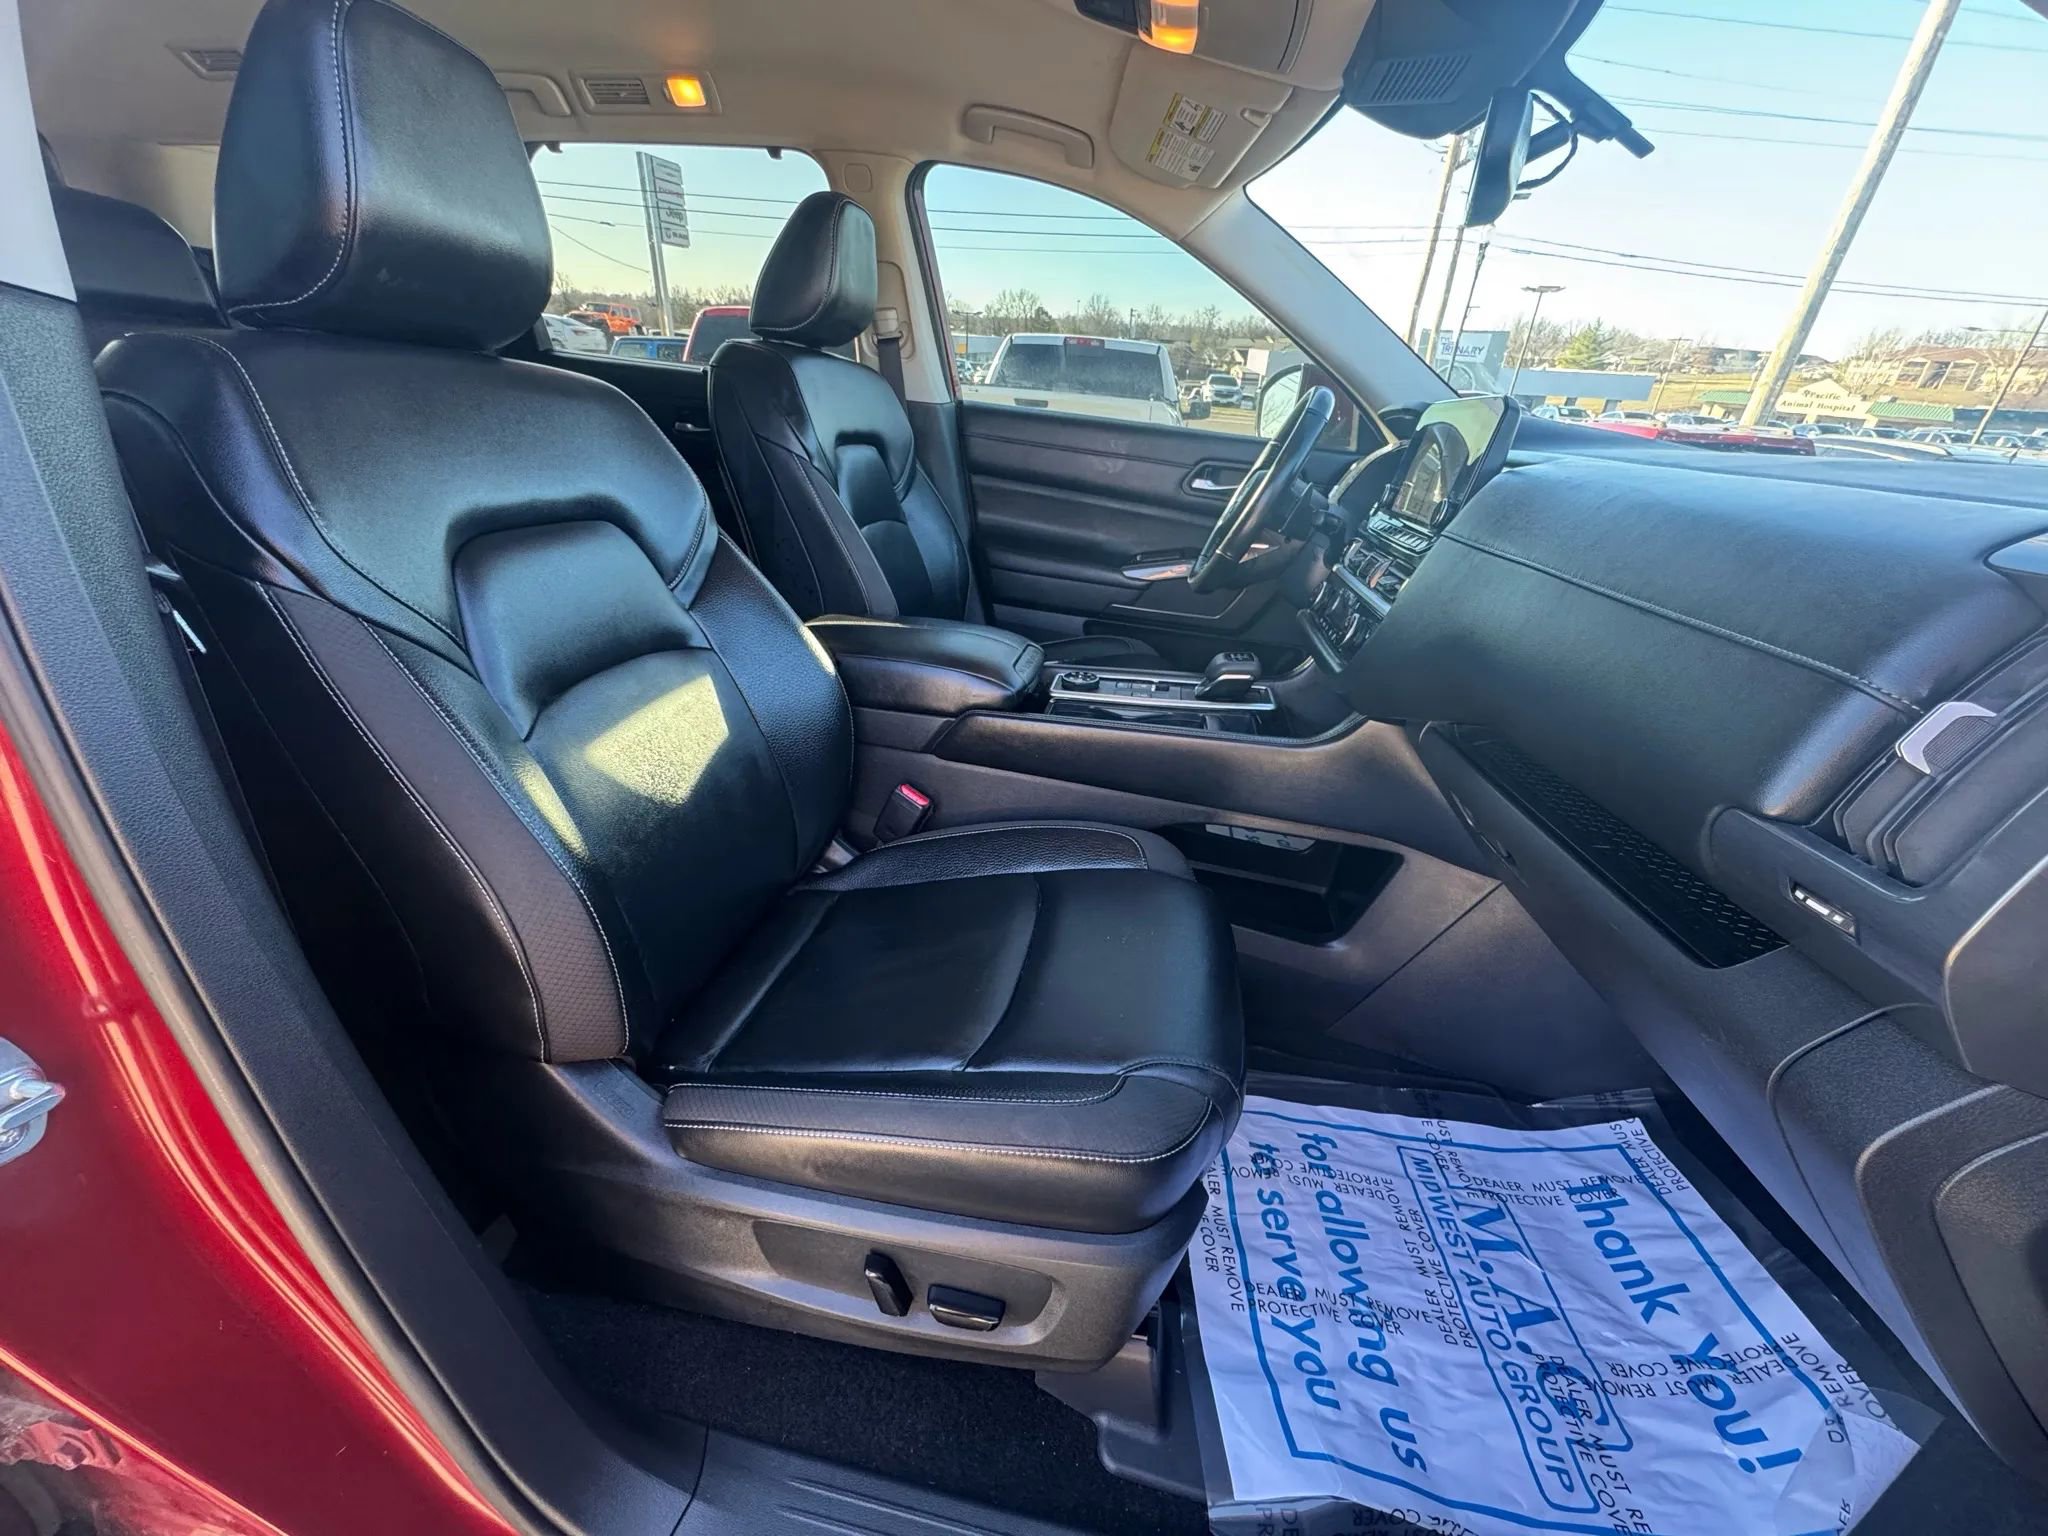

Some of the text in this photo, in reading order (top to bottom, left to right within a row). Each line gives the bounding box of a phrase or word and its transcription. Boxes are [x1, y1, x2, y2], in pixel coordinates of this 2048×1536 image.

[1780, 400, 1856, 412] Animal Hospital
[1296, 1132, 1338, 1179] for
[1436, 1120, 1480, 1200] UST REMOVE
[1610, 1123, 1636, 1150] MUS
[1630, 1128, 1690, 1192] PROTECTIVE
[1288, 1173, 1324, 1191] MUST
[1300, 1162, 1380, 1187] PROTECTIVE
[1334, 1181, 1385, 1201] DEALER
[1472, 1174, 1645, 1193] DEALER MUST REMOVE
[1482, 1188, 1620, 1207] PROTECTIVE COVER
[1632, 1157, 1673, 1196] DEALER
[1200, 1225, 1219, 1272] COVER
[1207, 1160, 1245, 1312] ALER MUST REMOVE
[1381, 1177, 1458, 1345] DEALER MUST REMOVE
[1249, 1141, 1341, 1411] to serve you
[1315, 1190, 1399, 1387] allowing
[1408, 1208, 1478, 1349] PROTECTIVE COVER
[1246, 1281, 1433, 1324] DEALER MUST REMOVE
[1249, 1300, 1404, 1336] PROTECTIVE COVER
[1410, 1156, 1575, 1493] MIDWEST AUTO GROUP
[1564, 1175, 1803, 1474] Thank You!
[1579, 1356, 1800, 1398] DEALER MUST REMOVE
[1607, 1342, 1785, 1378] PROTECTIVE COVER
[1781, 1331, 1854, 1408] REMOVE
[1837, 1362, 1886, 1419] OVER
[1379, 1407, 1427, 1473] us
[1534, 1353, 1632, 1536] PROTECTIVE COVE
[1549, 1355, 1632, 1494] DEALER MUST
